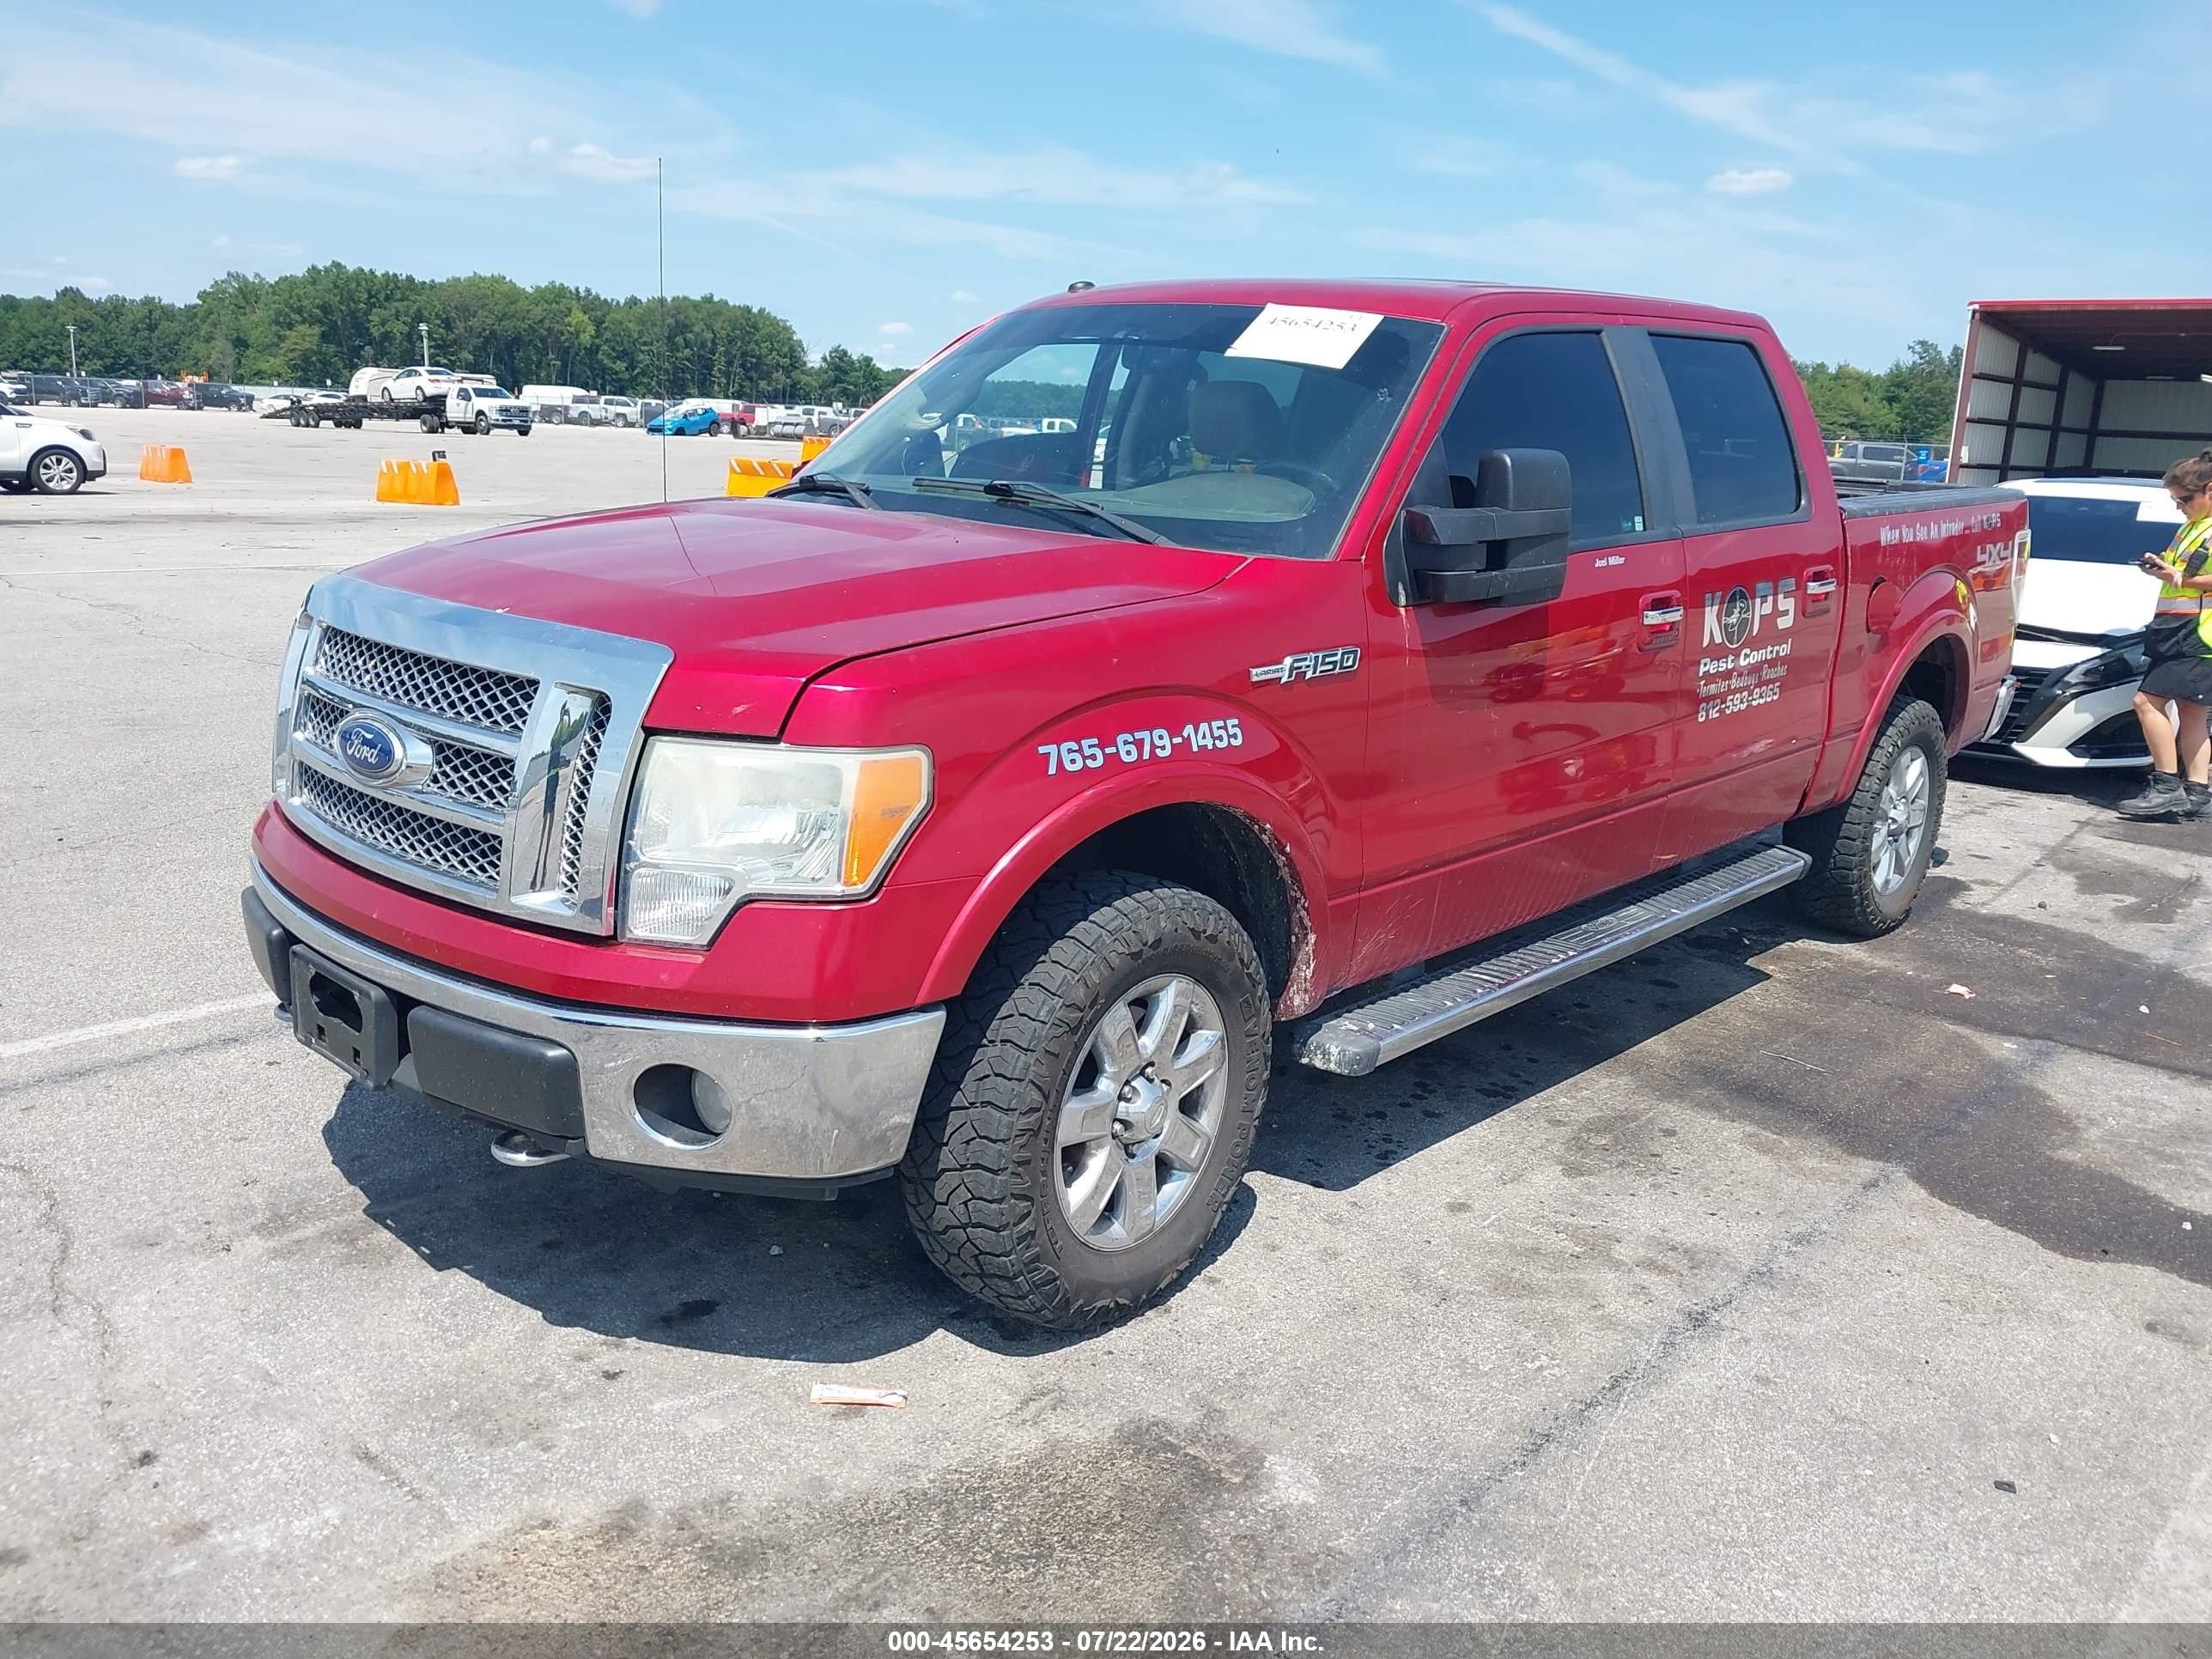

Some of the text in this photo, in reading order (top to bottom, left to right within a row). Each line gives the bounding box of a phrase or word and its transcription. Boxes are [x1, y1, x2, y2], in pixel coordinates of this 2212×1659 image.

[1881, 526, 1899, 546] When
[1902, 524, 1913, 542] You
[1917, 523, 1928, 541] See
[1930, 521, 1939, 538] An
[1595, 556, 1626, 567] Joel Miller
[1698, 639, 1792, 678] Pest Control
[1697, 682, 1781, 723] 812-593-9365
[346, 727, 382, 764] Ford
[1038, 718, 1243, 775] 765-679-1455
[1205, 1121, 1252, 1212] POWER
